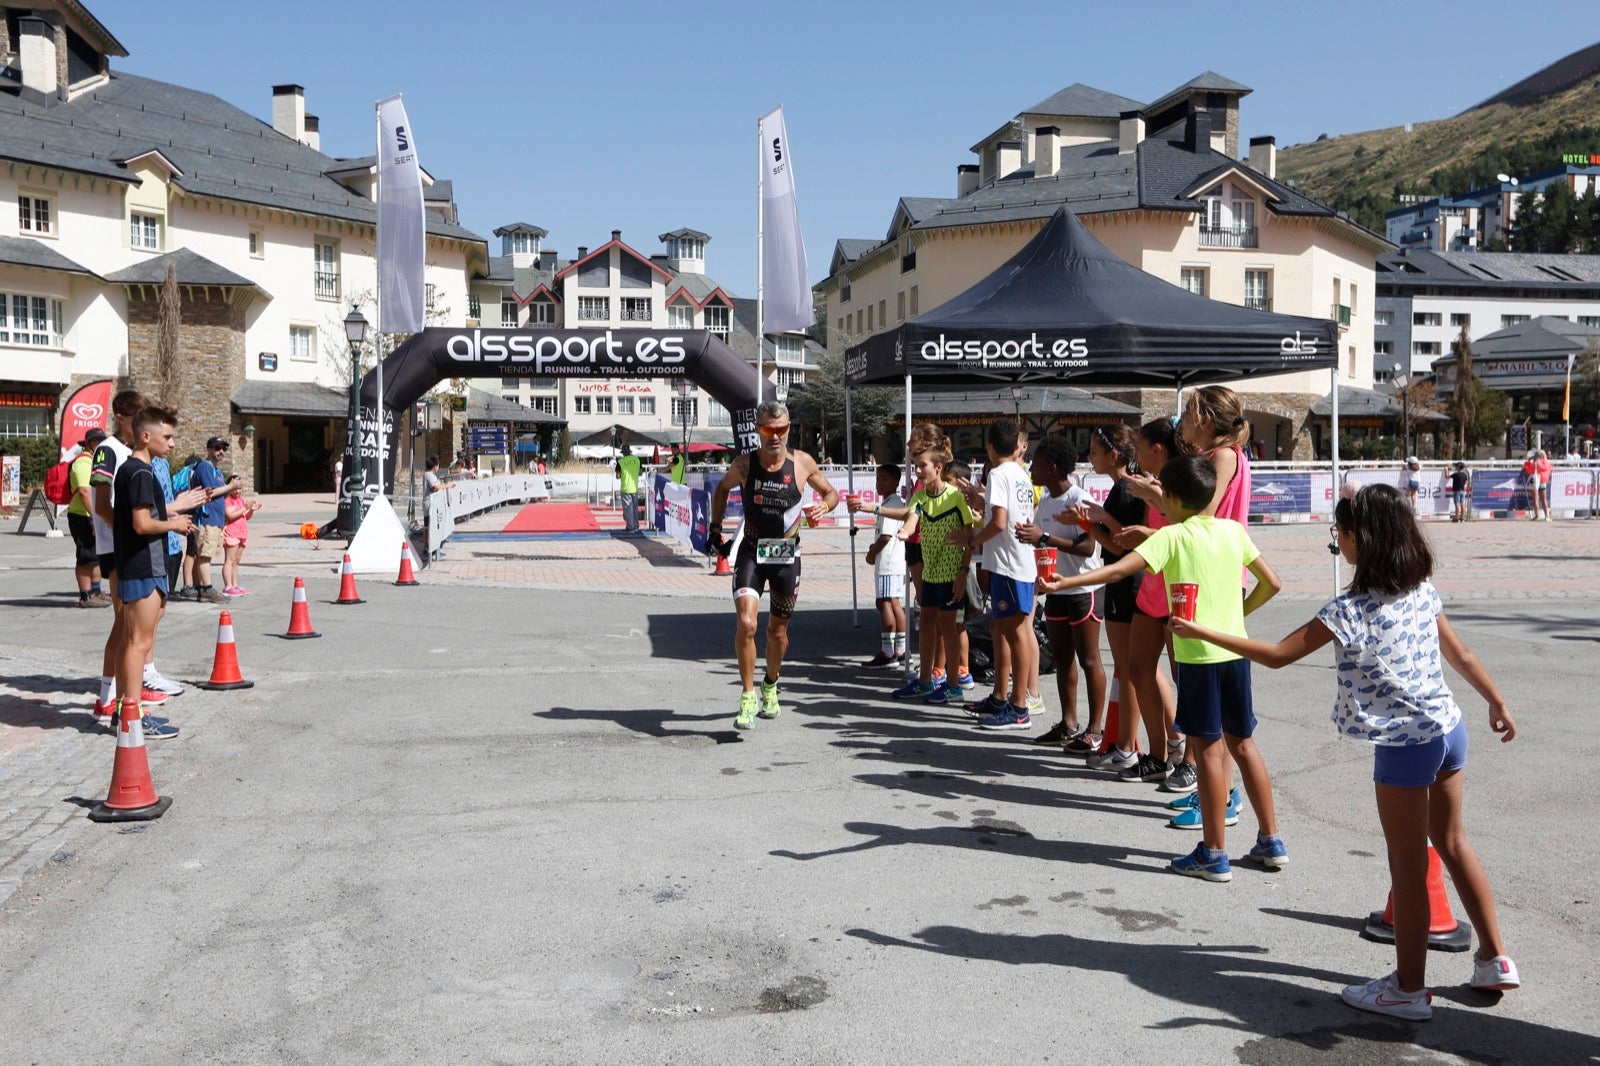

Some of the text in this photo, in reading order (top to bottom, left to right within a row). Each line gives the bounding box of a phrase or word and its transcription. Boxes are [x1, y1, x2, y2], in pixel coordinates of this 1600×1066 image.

[1562, 154, 1589, 164] HOTEL
[447, 329, 686, 374] alssport.es
[920, 333, 1089, 368] alssport.es
[1053, 360, 1089, 368] OUTDOOR
[499, 366, 686, 374] TIENDA RUNNING TRAIL OUTDOOR
[765, 545, 791, 557] 102
